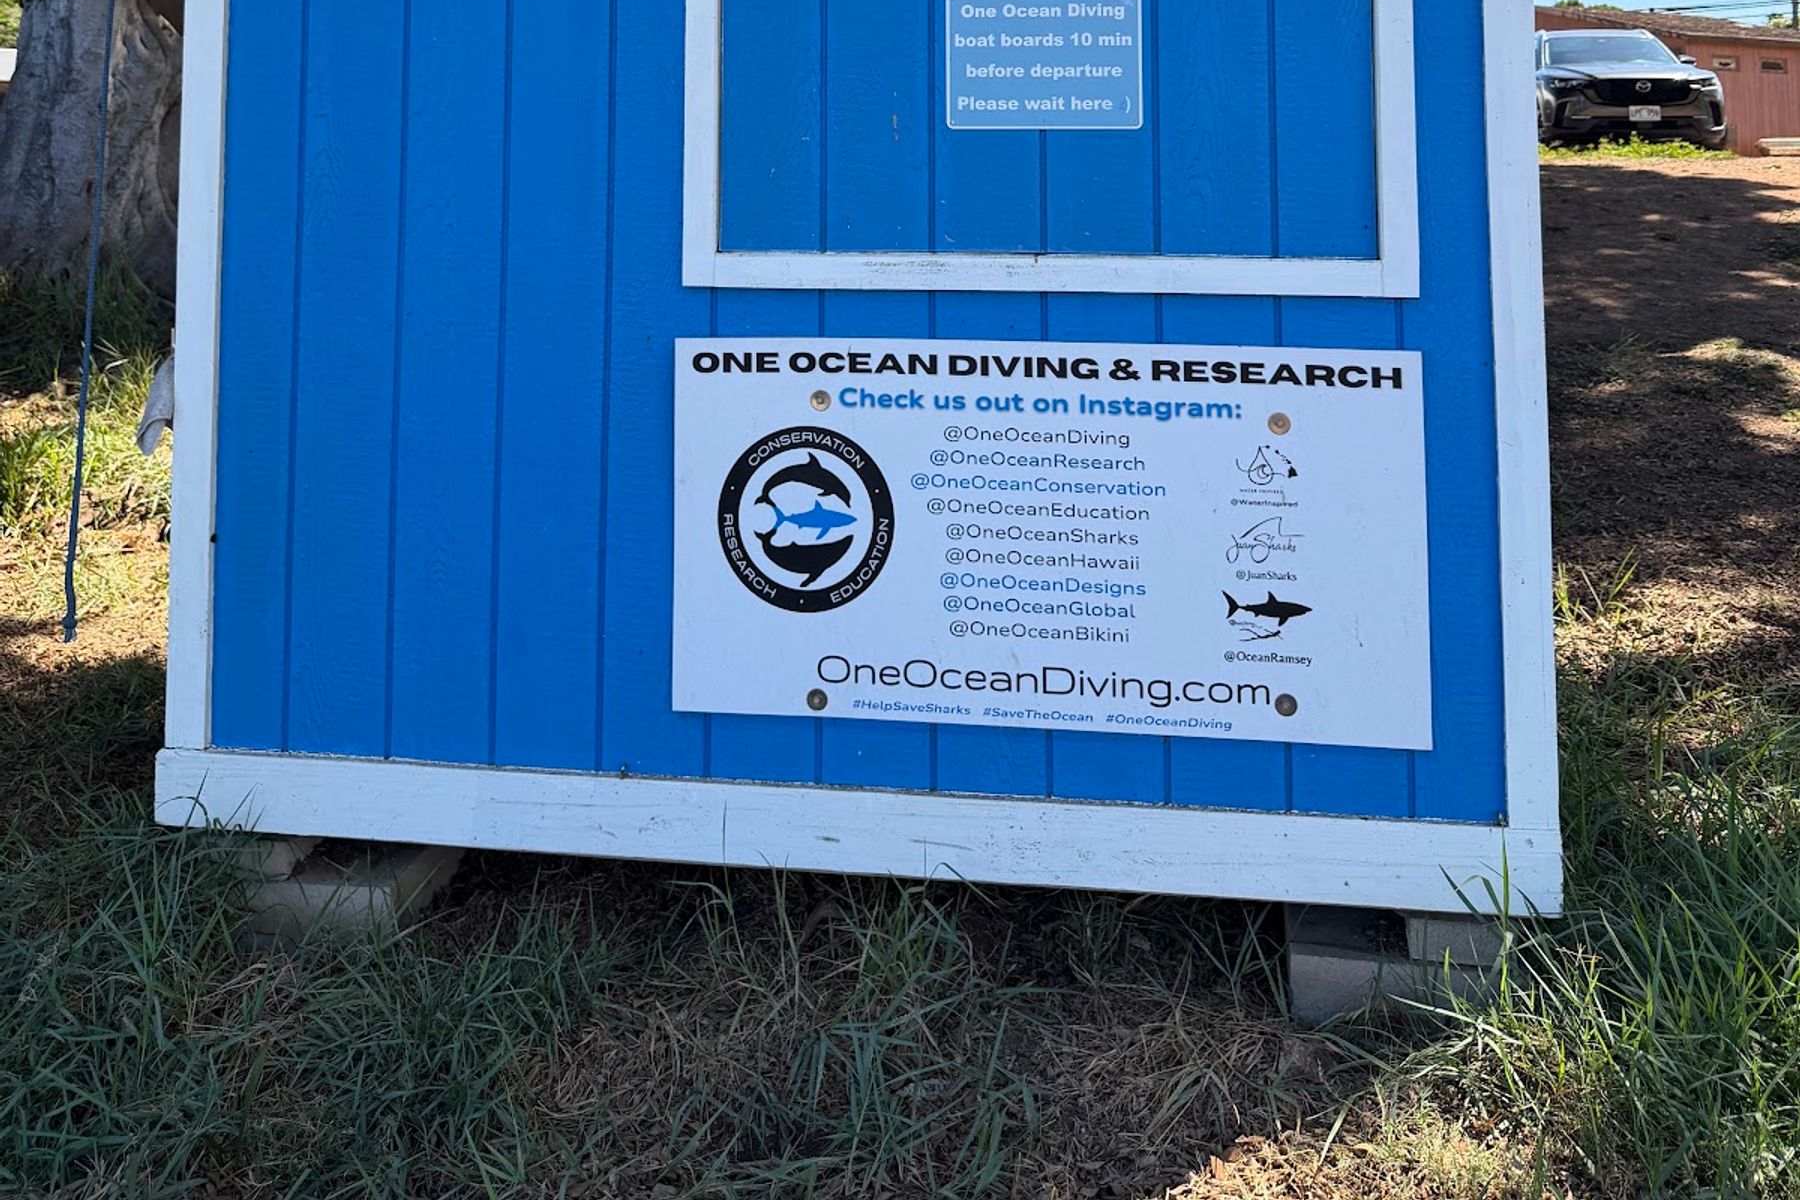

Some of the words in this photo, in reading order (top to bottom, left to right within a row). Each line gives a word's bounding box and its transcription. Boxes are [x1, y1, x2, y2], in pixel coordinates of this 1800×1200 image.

[960, 4, 997, 18] One
[1002, 3, 1061, 18] Ocean
[1068, 3, 1125, 20] Diving
[954, 33, 995, 48] boat
[1000, 33, 1064, 47] boards
[1070, 32, 1092, 46] 10
[1098, 32, 1133, 46] min
[966, 63, 1025, 78] before
[1030, 63, 1123, 80] departure
[957, 96, 1019, 111] Please
[1025, 96, 1065, 111] wait
[1071, 95, 1113, 111] here
[692, 351, 780, 374] ONE
[788, 351, 938, 376] OCEAN
[948, 355, 1100, 380] DIVING
[1108, 358, 1141, 382] &
[1151, 359, 1403, 390] RESEARCH
[838, 386, 925, 411] Check
[933, 393, 967, 411] us
[975, 393, 1025, 414] out
[1032, 397, 1069, 415] on
[1079, 394, 1243, 421] Instagram:
[943, 425, 1131, 449] @OneOceanDiving
[748, 431, 865, 470] CONSERVATION
[929, 449, 1146, 472] @OneOceanResearch
[910, 472, 1167, 497] @OneOceanConservation
[926, 497, 1151, 521] @OneOceanEducation
[945, 523, 1139, 546] @OneOceanSharks
[723, 513, 777, 598] RESEARCH
[829, 517, 889, 604] EDUCATION
[945, 547, 1140, 571] @OneOceanHawaii
[940, 572, 1147, 598] @OneOceanDesigns
[1235, 569, 1298, 582] @JuanSharks
[943, 596, 1136, 619] @OneOceanGlobal
[949, 620, 1130, 643] @OneOceanBikini
[1223, 650, 1313, 667] @OceanRamsey
[817, 655, 1271, 708] OneOceanDiving.com
[852, 699, 971, 716] #HelpSaveSharks
[982, 707, 1094, 723] #SaveTheOcean
[1105, 712, 1233, 731] #OneOceanDiving
